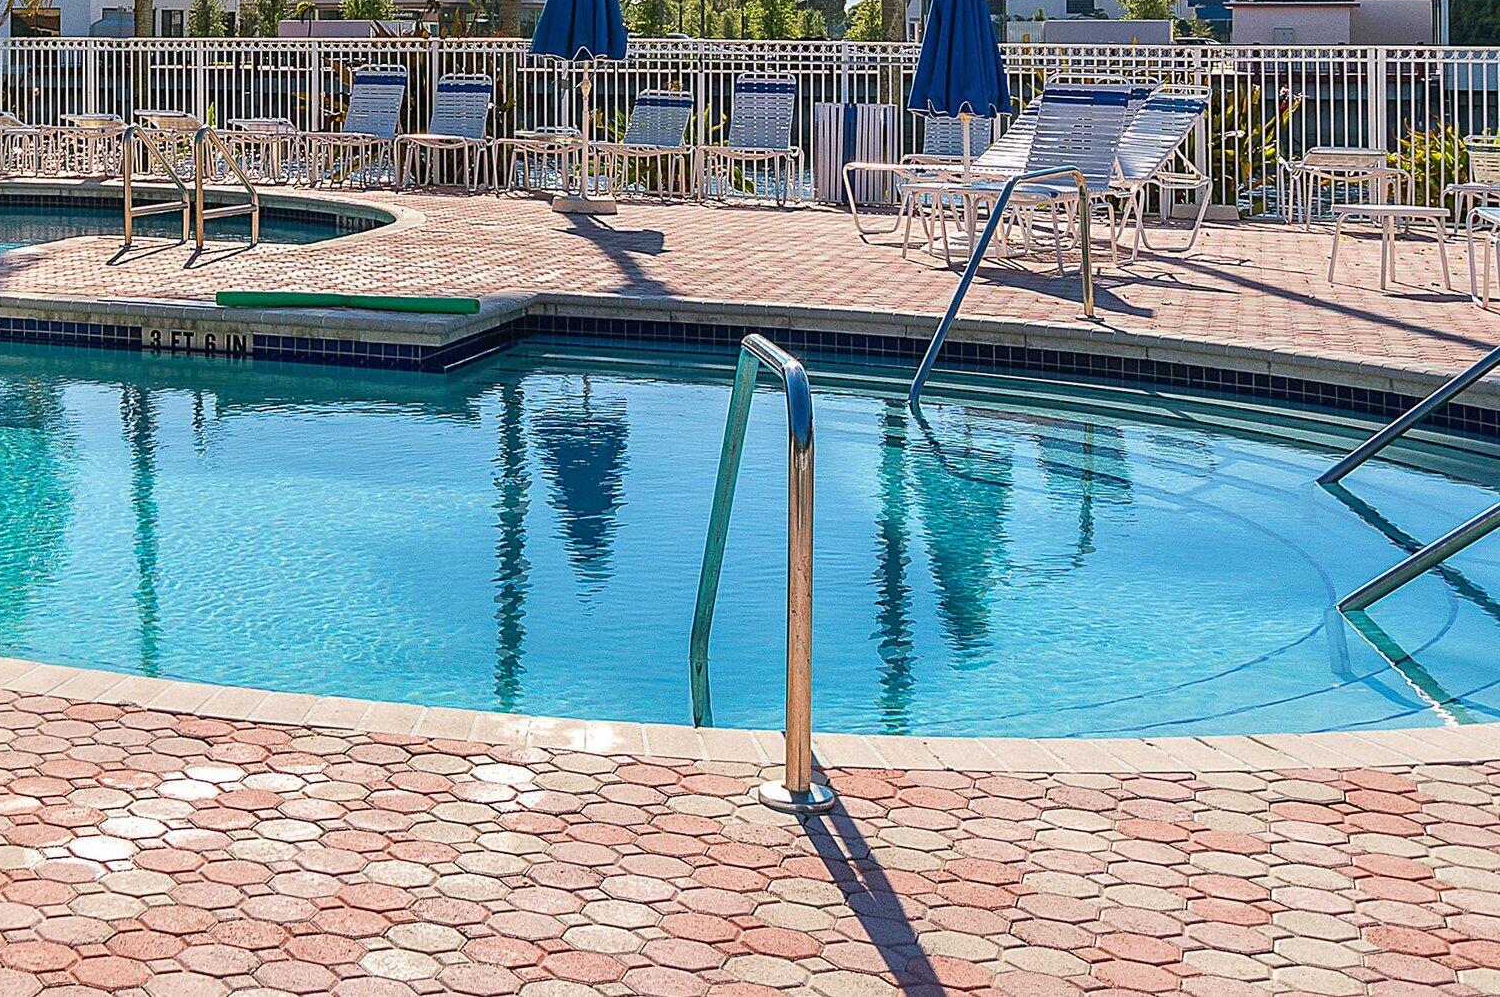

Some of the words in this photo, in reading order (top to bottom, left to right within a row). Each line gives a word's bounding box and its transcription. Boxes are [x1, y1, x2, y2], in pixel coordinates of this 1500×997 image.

[150, 330, 161, 348] 3
[171, 331, 194, 351] FT
[205, 333, 216, 353] 6
[226, 334, 247, 355] IN
